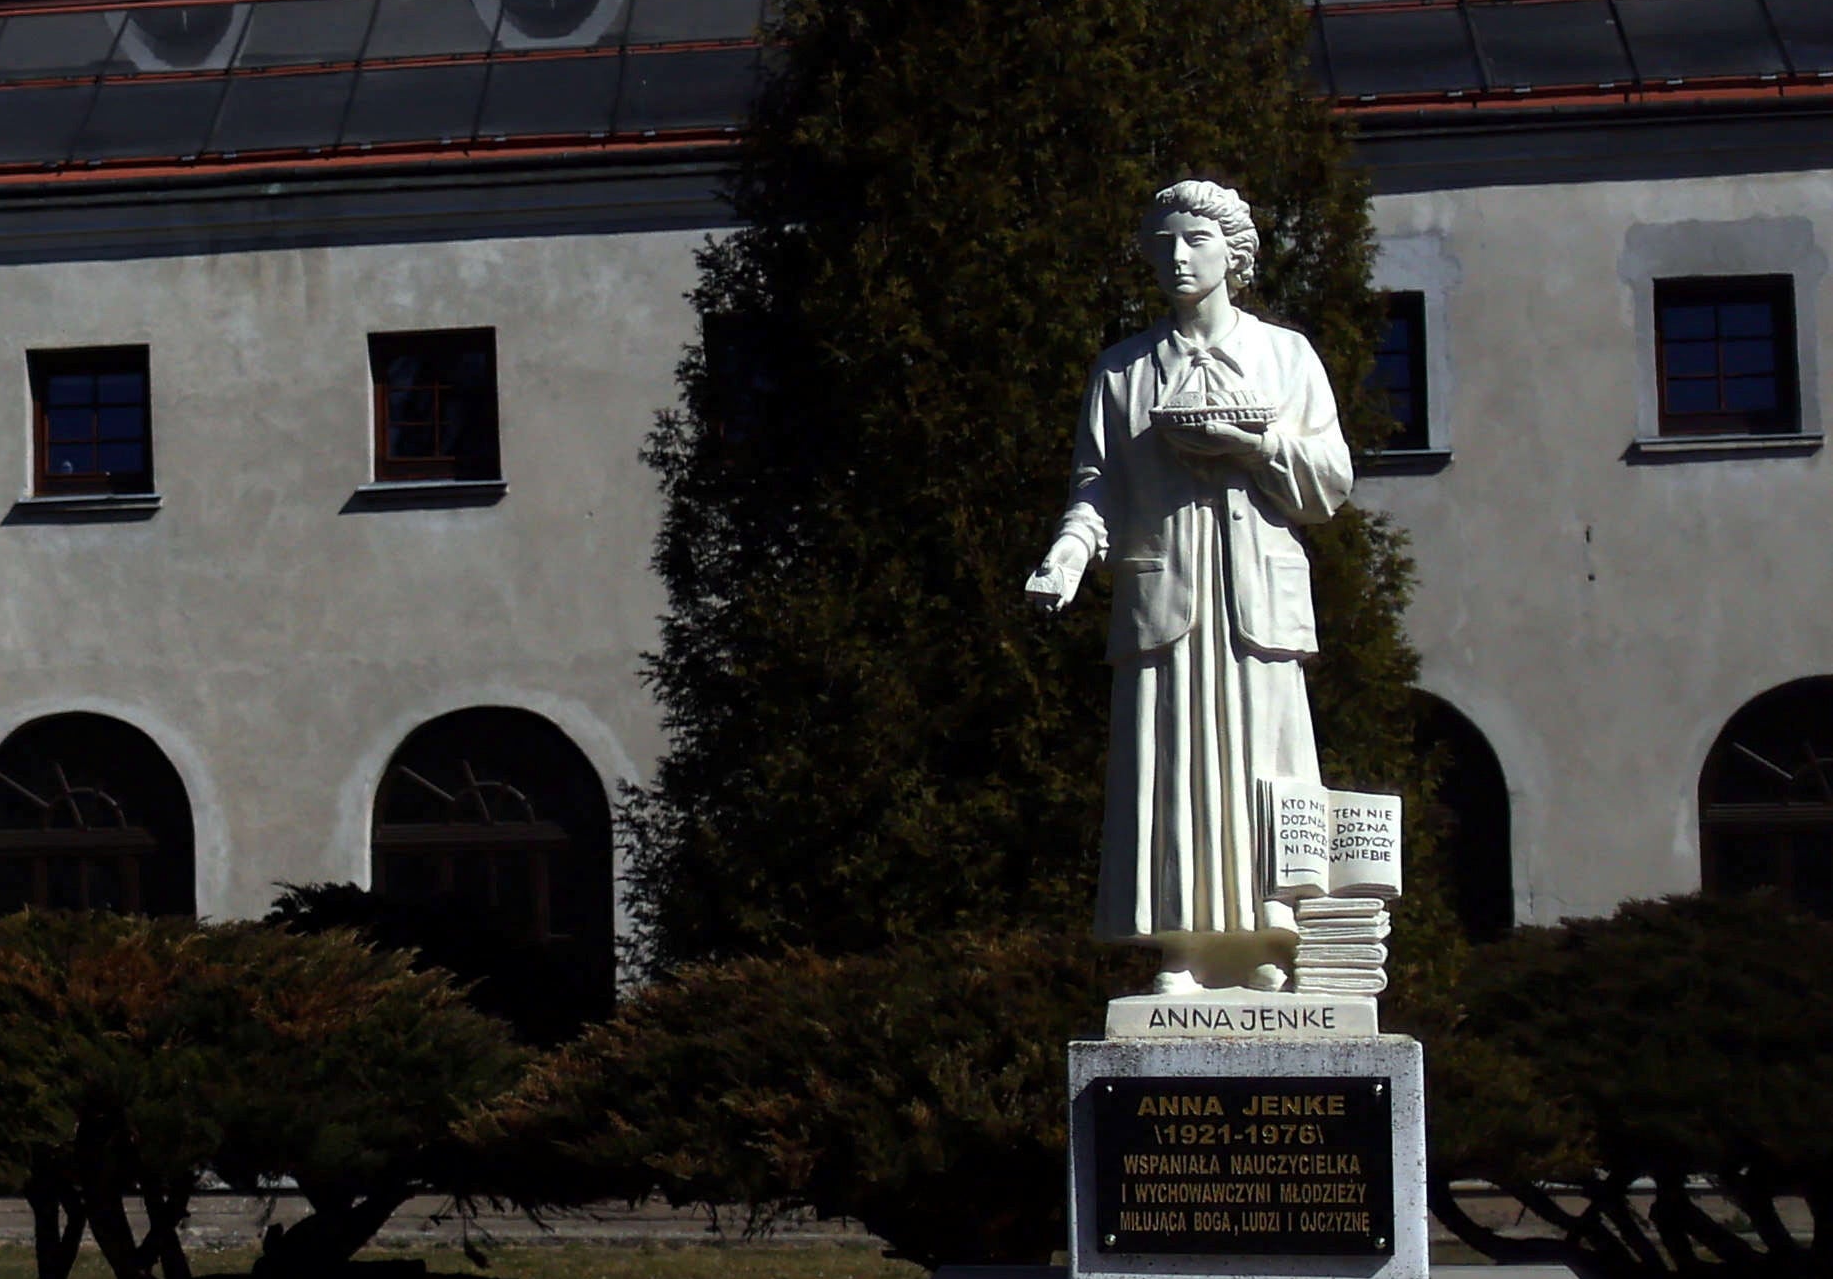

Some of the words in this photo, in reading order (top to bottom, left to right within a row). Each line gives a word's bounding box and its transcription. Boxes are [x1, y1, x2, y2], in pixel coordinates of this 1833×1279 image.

[1281, 799, 1305, 810] KTO
[1333, 808, 1360, 819] TEN
[1367, 810, 1392, 821] NIE
[1337, 822, 1388, 834] DOZNA
[1280, 829, 1327, 846] GORYCZ
[1331, 836, 1395, 850] SŁODYCZY
[1284, 844, 1299, 855] NI
[1330, 853, 1342, 863] W
[1345, 849, 1391, 862] NIEBIE
[1149, 1008, 1233, 1030] ANNA
[1240, 1008, 1335, 1031] JENKE
[1137, 1096, 1224, 1116] ANNA
[1242, 1095, 1346, 1117] JENKE
[1123, 1154, 1221, 1176] WSPANIAŁA
[1231, 1154, 1361, 1175] NAUCZYCIELKA
[1121, 1184, 1126, 1204] I
[1135, 1183, 1272, 1204] WYCHOWAWCZYNI
[1280, 1179, 1366, 1204] MŁODZIEŻY
[1120, 1211, 1187, 1236] MIŁUJĄCA
[1242, 1212, 1280, 1232] LUDZI
[1287, 1212, 1293, 1232] I
[1300, 1211, 1370, 1237] OJCZYZNĘ
